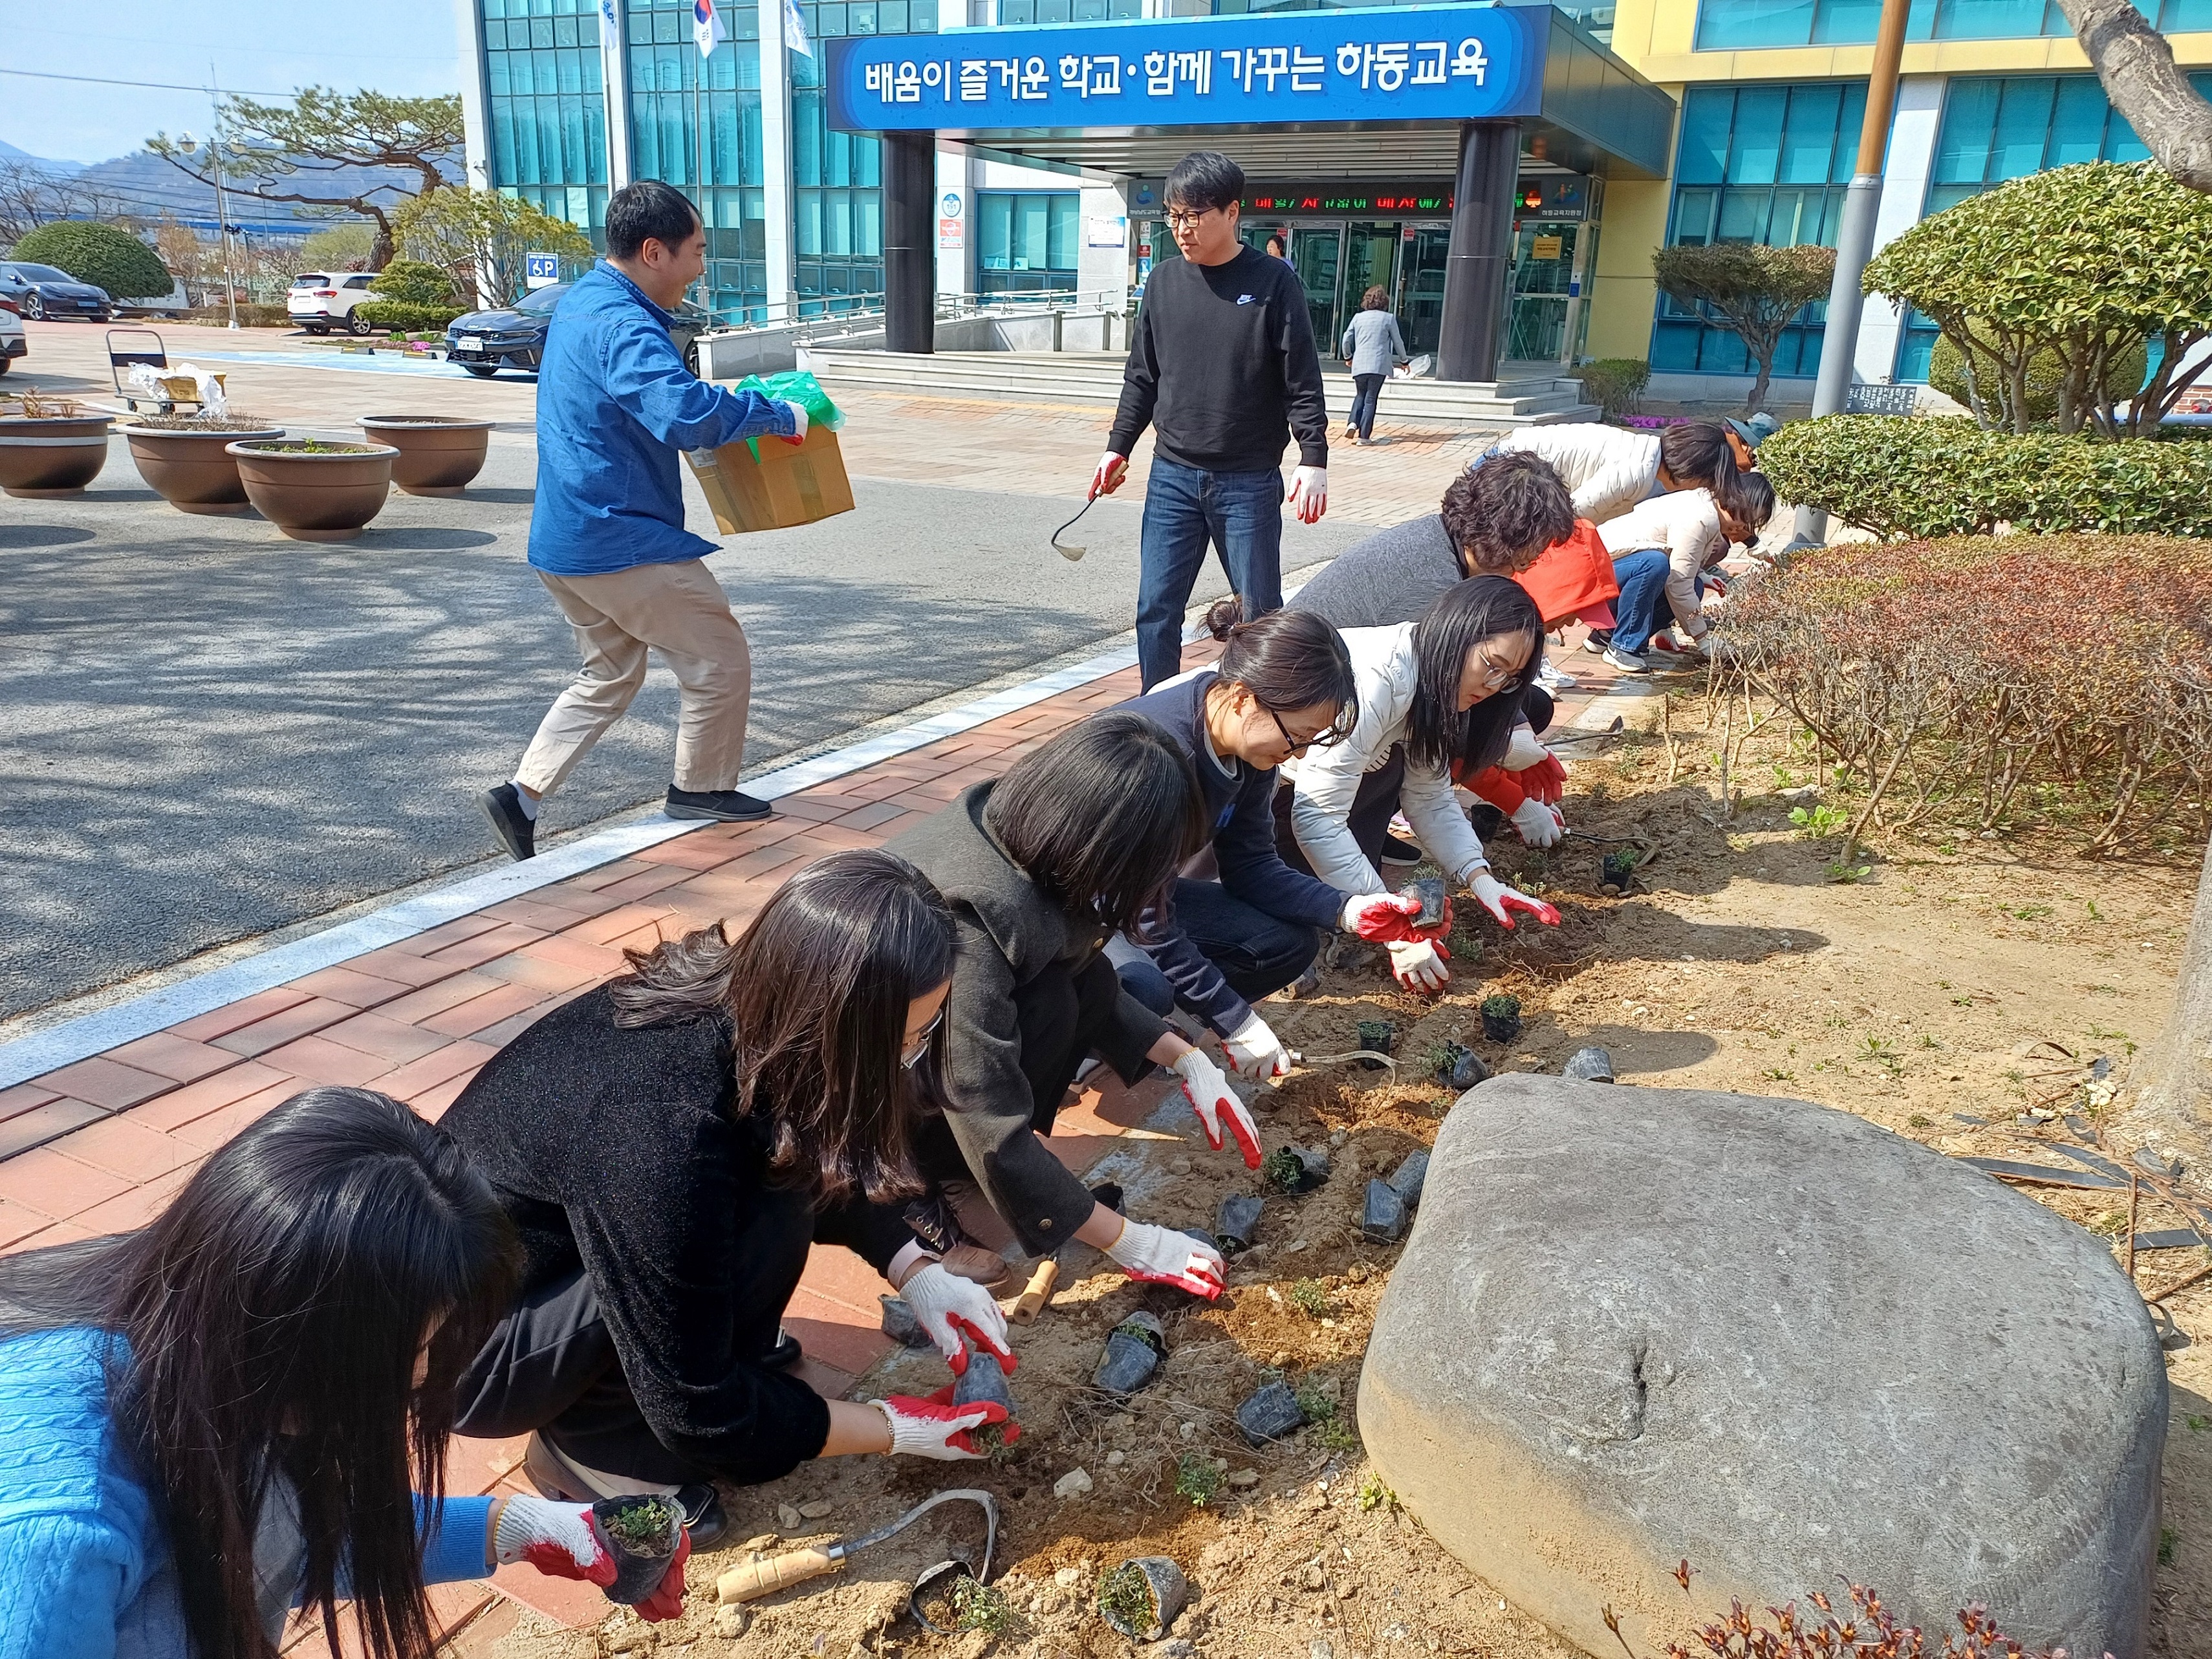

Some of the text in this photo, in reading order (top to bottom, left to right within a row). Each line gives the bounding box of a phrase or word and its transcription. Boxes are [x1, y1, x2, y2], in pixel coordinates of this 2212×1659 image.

[867, 61, 951, 102] 배움이
[960, 58, 1049, 100] 즐거운
[1221, 47, 1325, 92] 가꾸는
[1337, 38, 1488, 90] 하동교육
[545, 261, 554, 276] P
